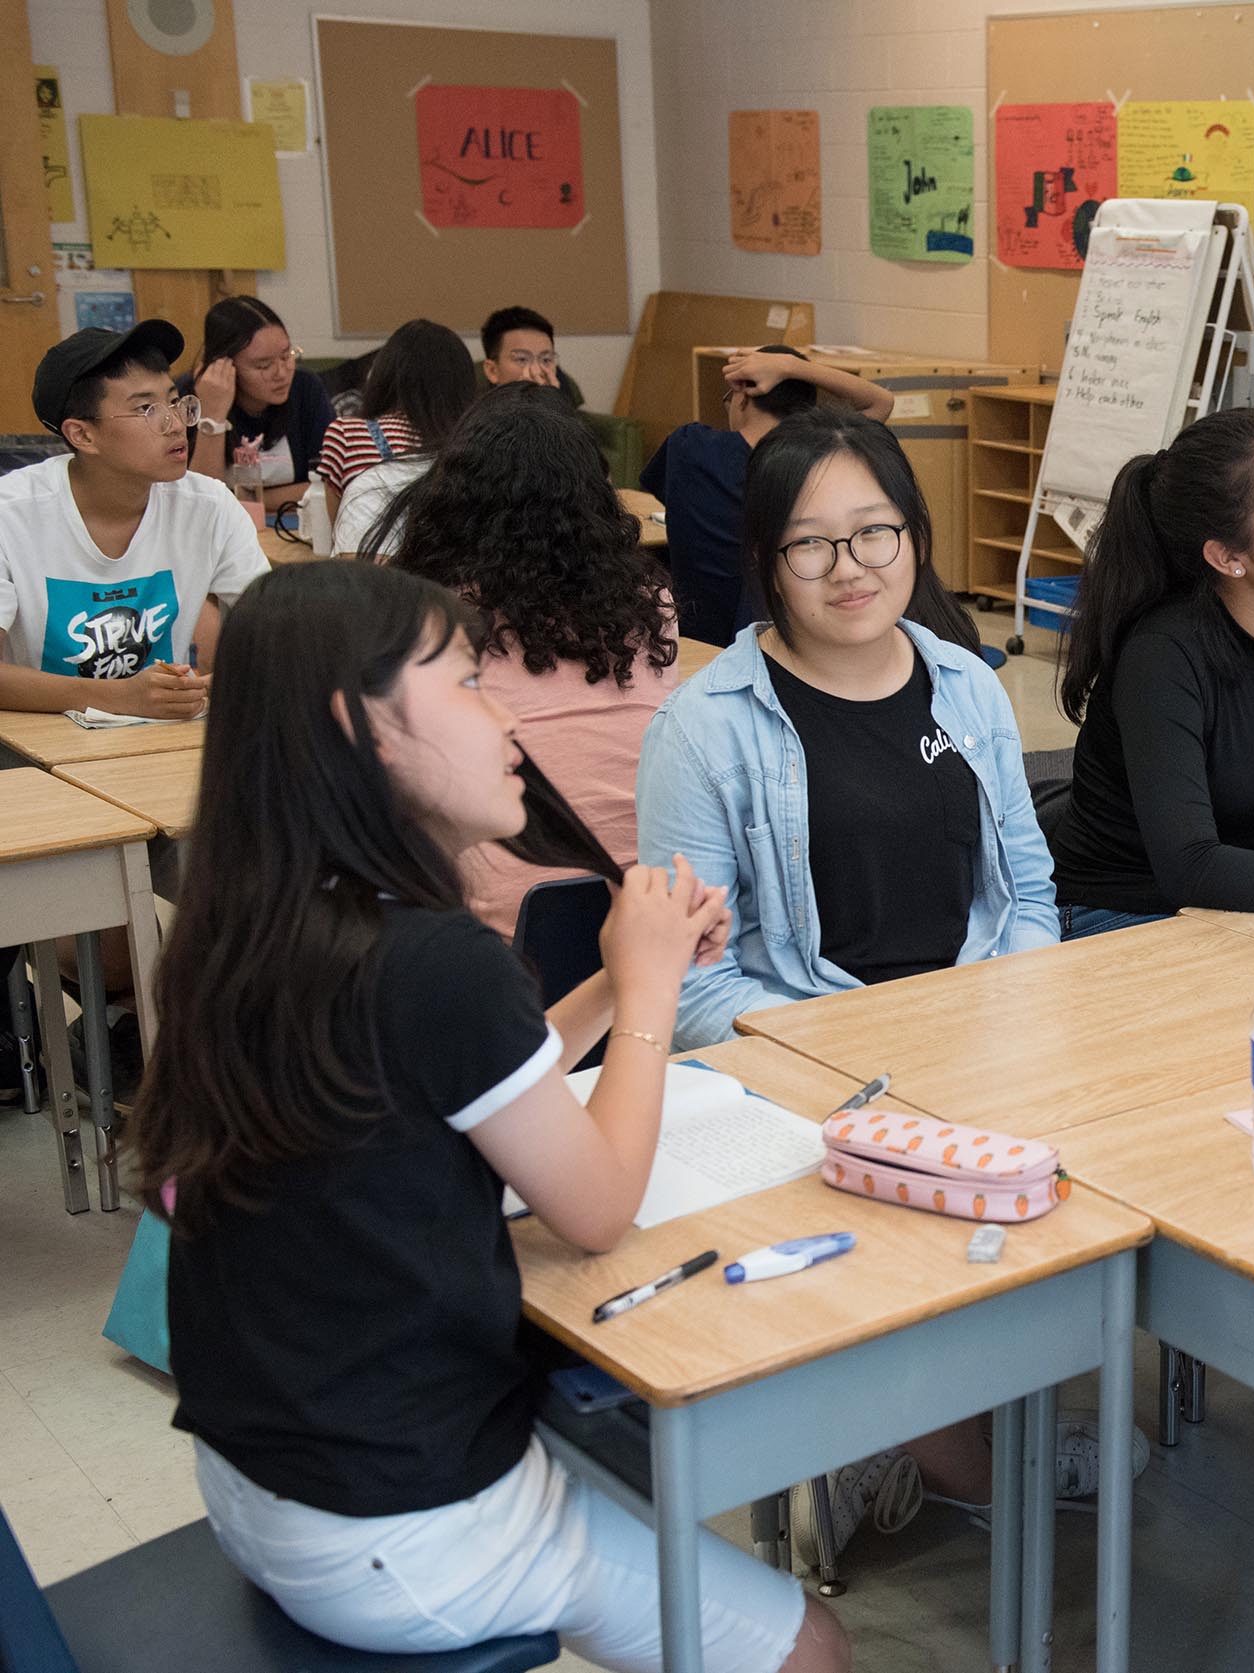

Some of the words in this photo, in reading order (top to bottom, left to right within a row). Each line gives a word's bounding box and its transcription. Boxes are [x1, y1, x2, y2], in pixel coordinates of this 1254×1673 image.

[459, 127, 543, 161] ALICE
[903, 159, 937, 205] John
[62, 602, 170, 665] STRIVE
[92, 653, 139, 680] FOR
